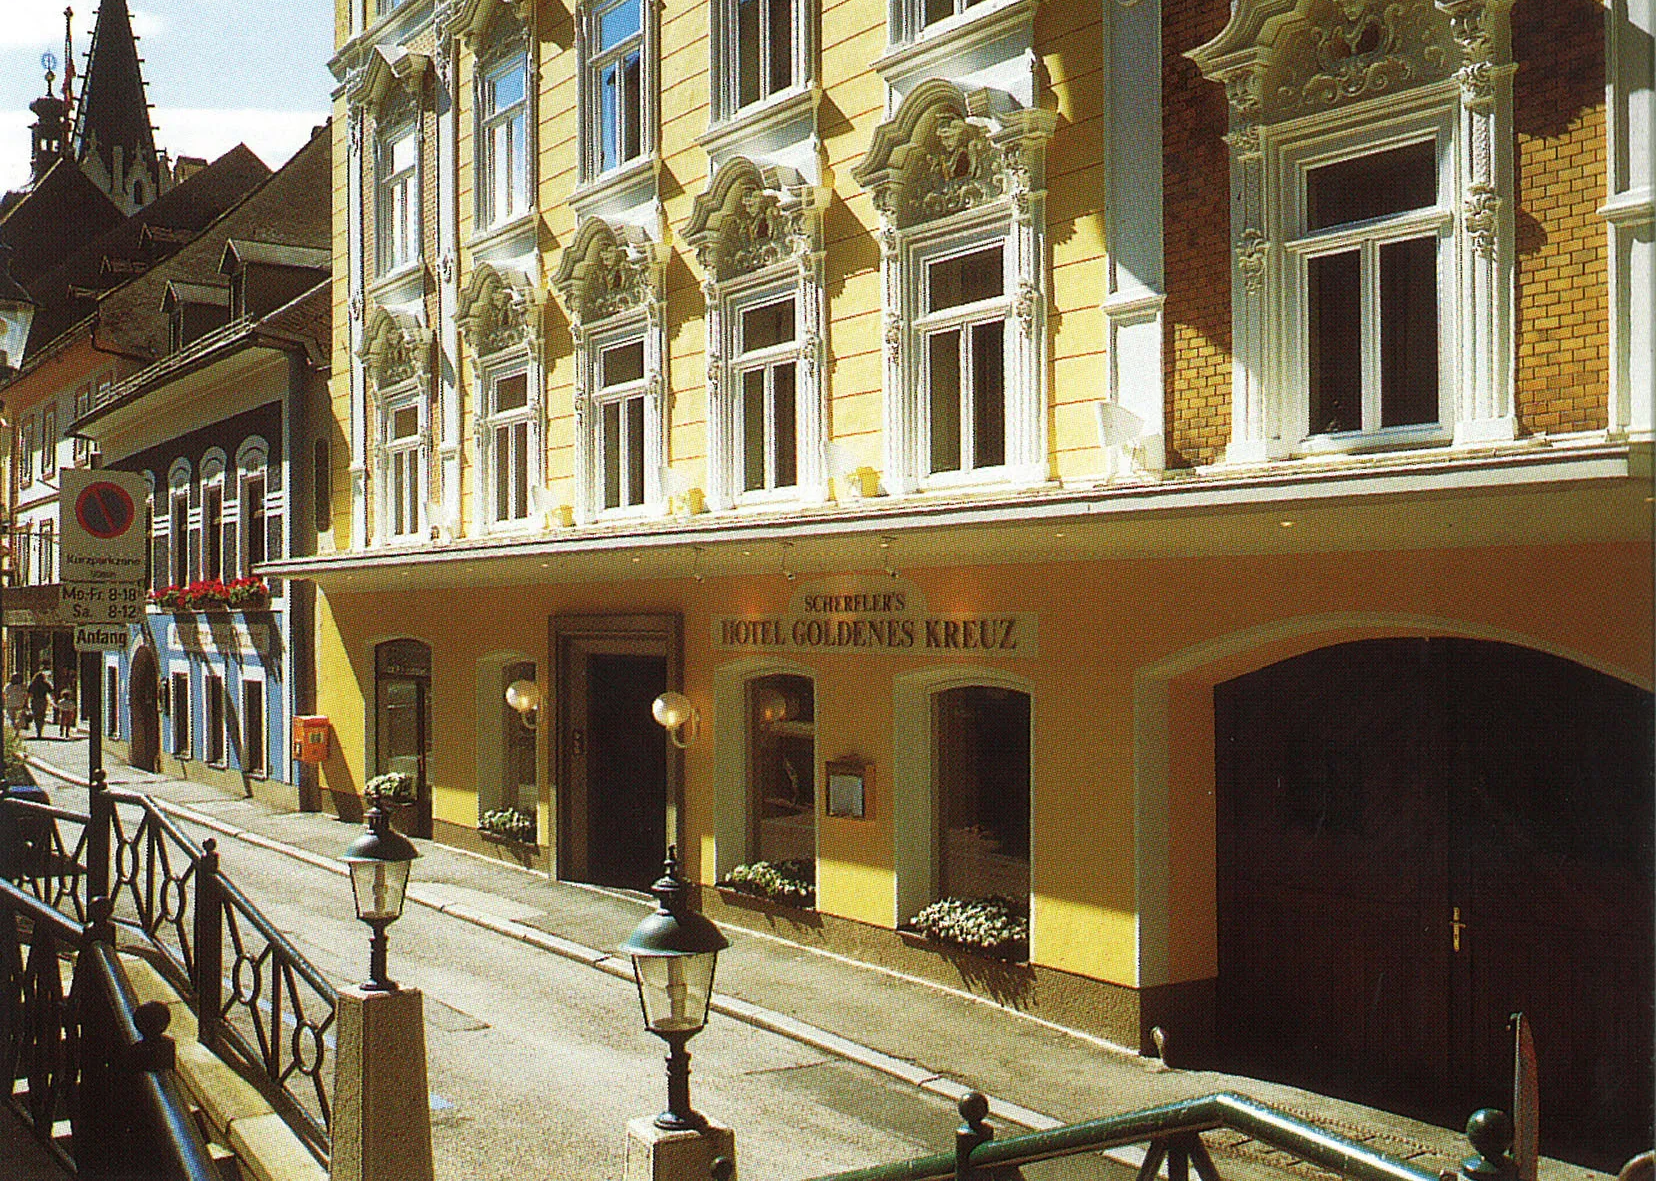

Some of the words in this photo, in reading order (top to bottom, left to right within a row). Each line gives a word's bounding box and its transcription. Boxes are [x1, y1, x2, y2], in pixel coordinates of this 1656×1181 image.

[804, 592, 905, 613] SCHERFLER'S
[77, 629, 127, 648] Anfang
[721, 618, 786, 647] HOTEL
[792, 618, 915, 649] GOLDENES
[925, 619, 1017, 650] KREUZ
